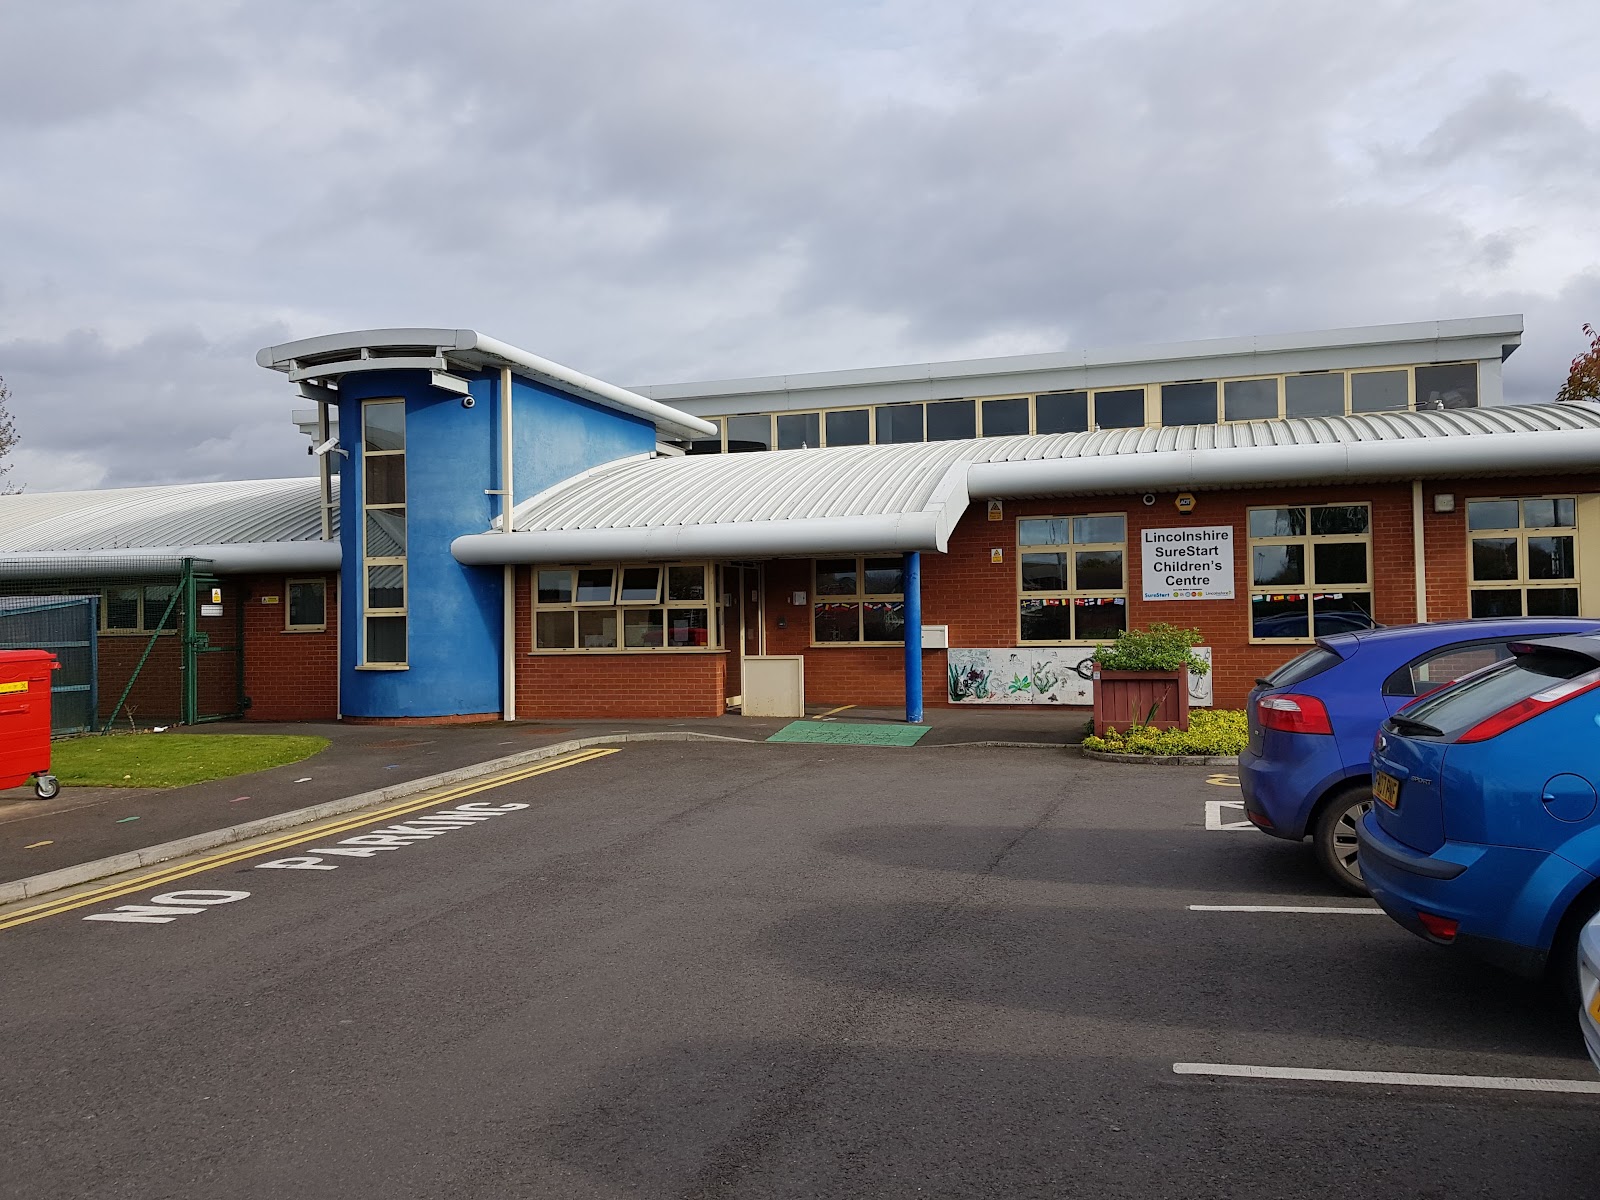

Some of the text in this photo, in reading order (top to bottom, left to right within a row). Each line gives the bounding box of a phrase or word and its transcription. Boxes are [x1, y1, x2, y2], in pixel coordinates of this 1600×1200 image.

[1145, 530, 1229, 543] Lincolnshire
[1155, 545, 1219, 557] SureStart
[1153, 560, 1222, 572] Children's
[1165, 575, 1210, 586] Centre
[1411, 776, 1432, 785] SPORT
[82, 801, 531, 924] NO PARKING
